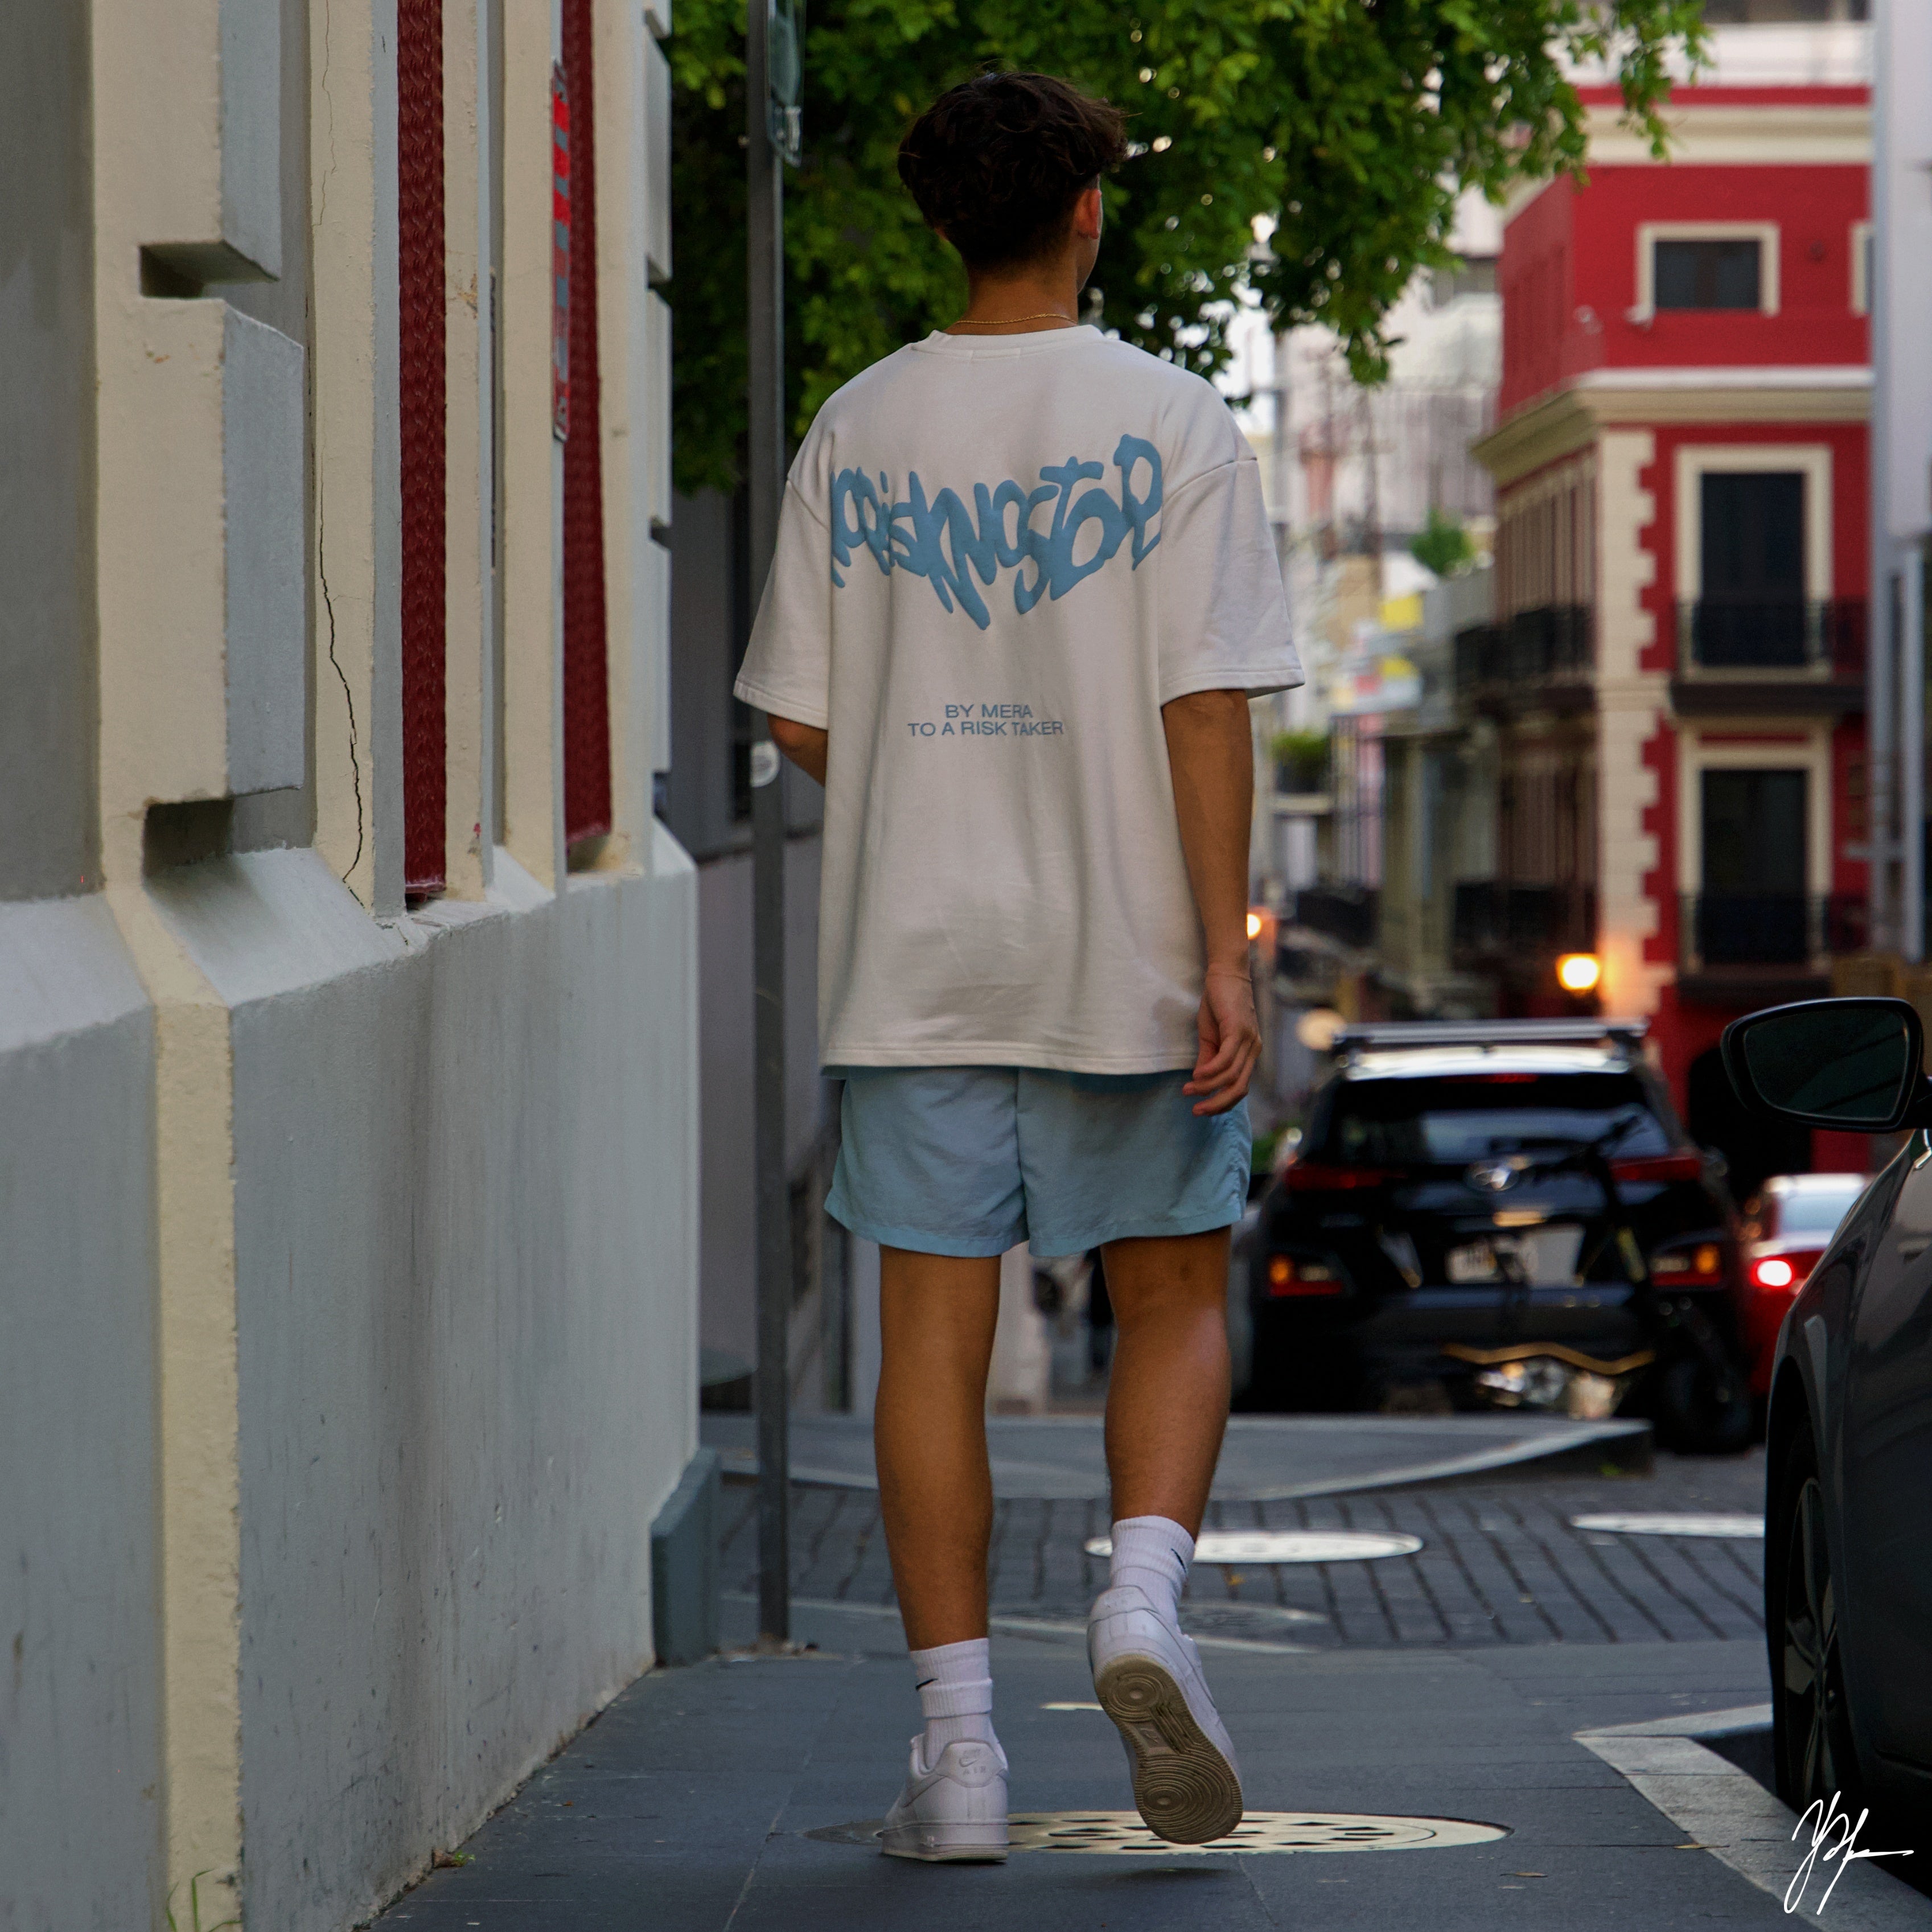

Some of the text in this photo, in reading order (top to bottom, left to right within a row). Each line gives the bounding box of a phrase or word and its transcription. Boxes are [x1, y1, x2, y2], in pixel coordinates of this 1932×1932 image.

[944, 704, 1033, 718] BY MERA
[907, 721, 1064, 737] TO A RISK TAKER
